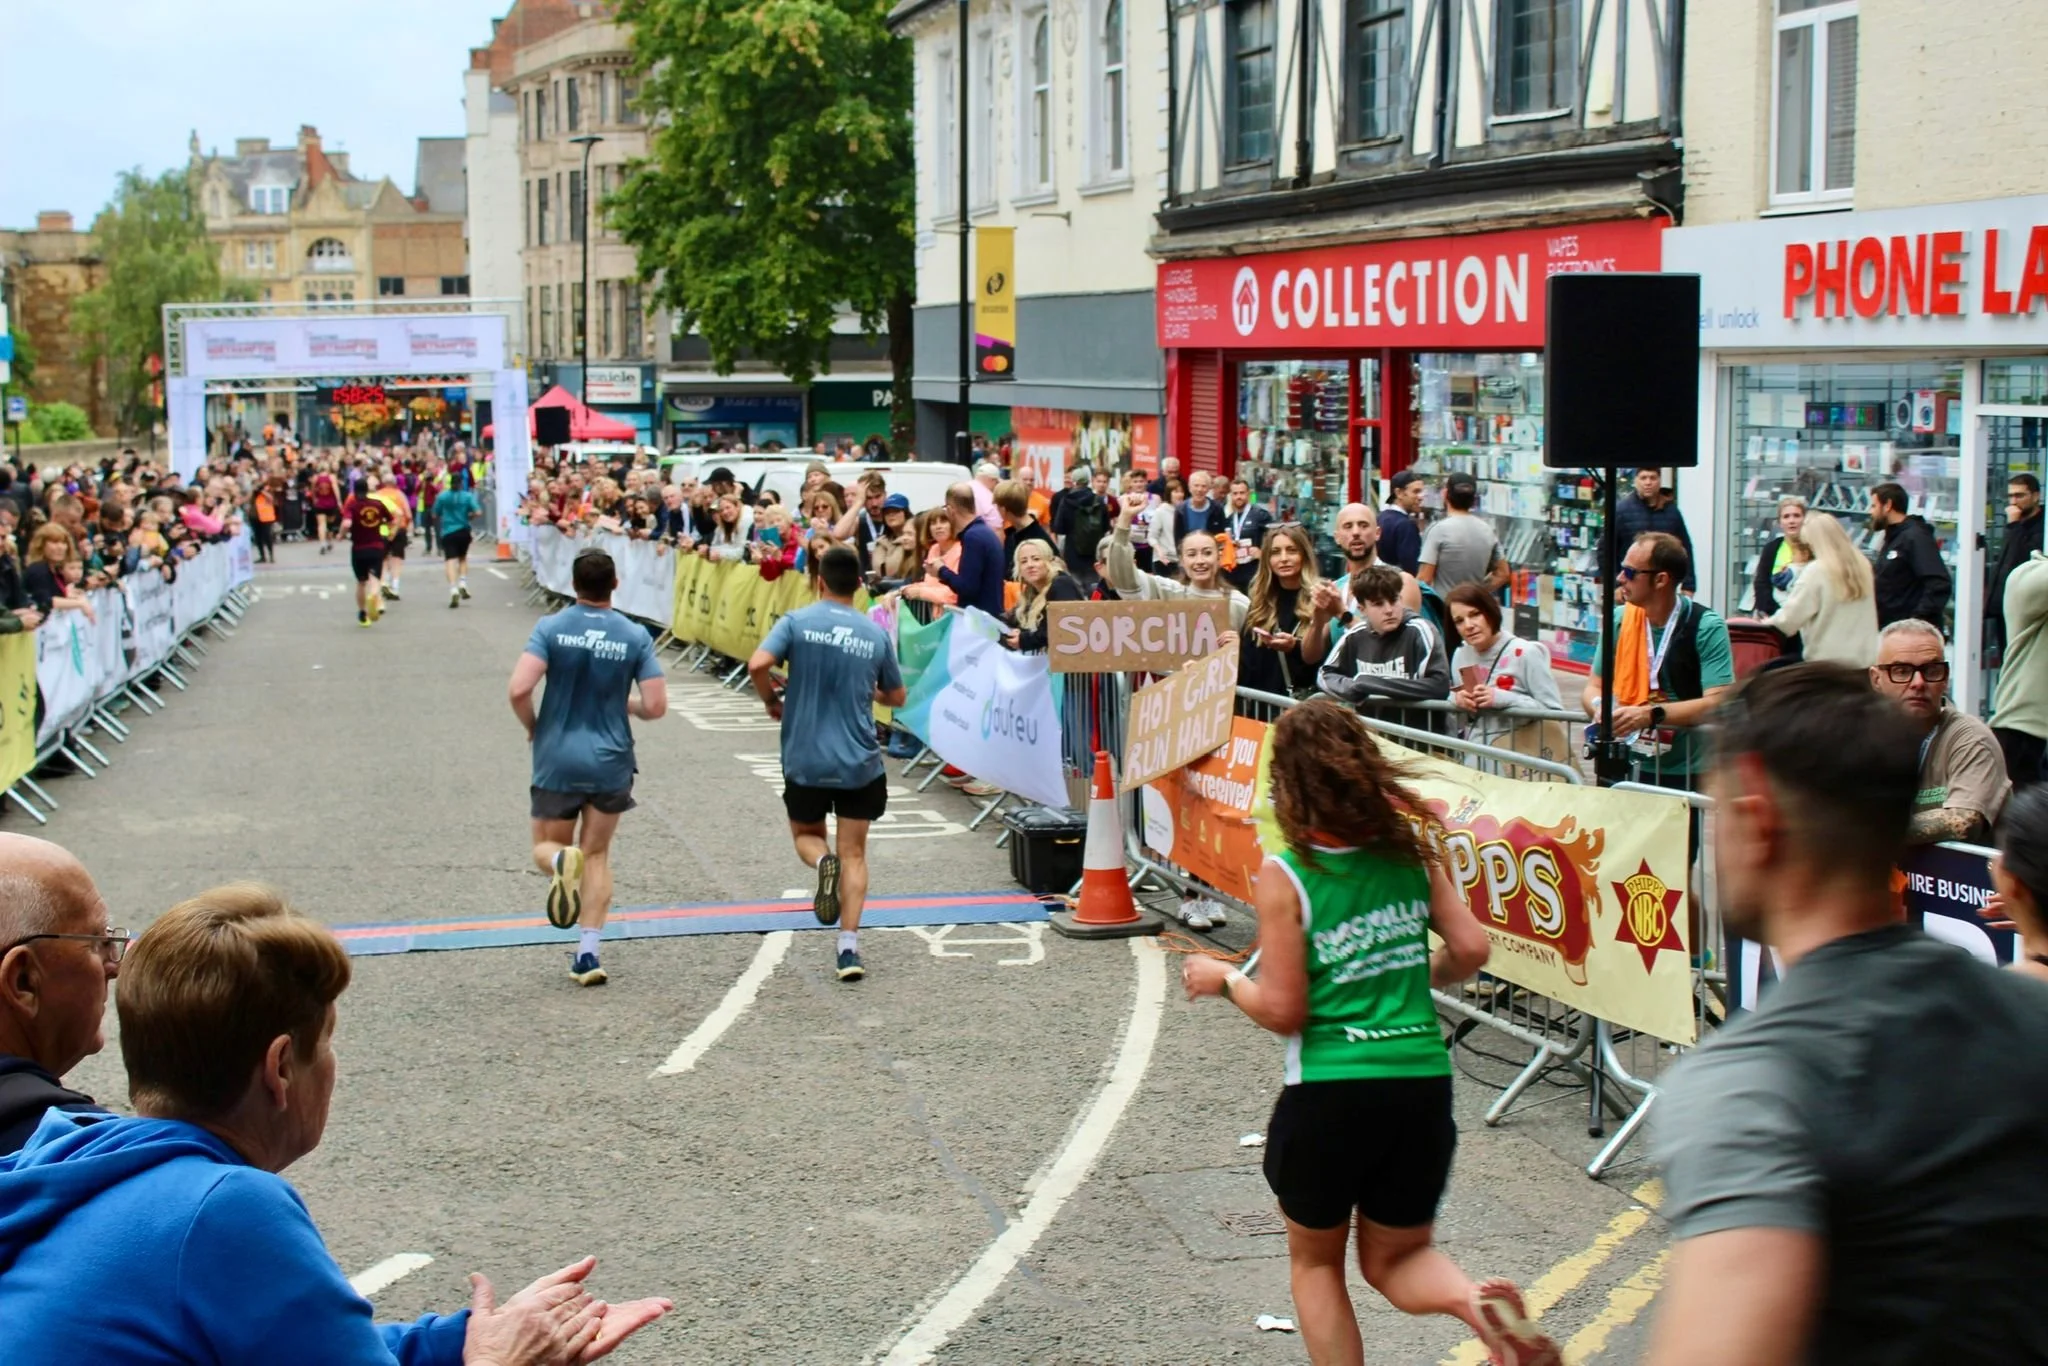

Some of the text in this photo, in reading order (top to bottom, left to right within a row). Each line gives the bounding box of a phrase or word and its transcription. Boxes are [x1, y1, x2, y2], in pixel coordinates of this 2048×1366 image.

[1546, 234, 1578, 257] VAPES
[1271, 252, 1529, 330] COLLECTION
[1783, 230, 1965, 320] PHONE
[1718, 306, 1760, 329] unlock
[1055, 611, 1220, 657] SORCHA
[1137, 650, 1239, 737] HOT GIRLS
[1125, 699, 1229, 786] RUN HALF
[1227, 736, 1259, 769] you
[1626, 876, 1665, 900] PHIPPS
[1633, 894, 1662, 942] NBC
[1501, 936, 1557, 969] COMPANY
